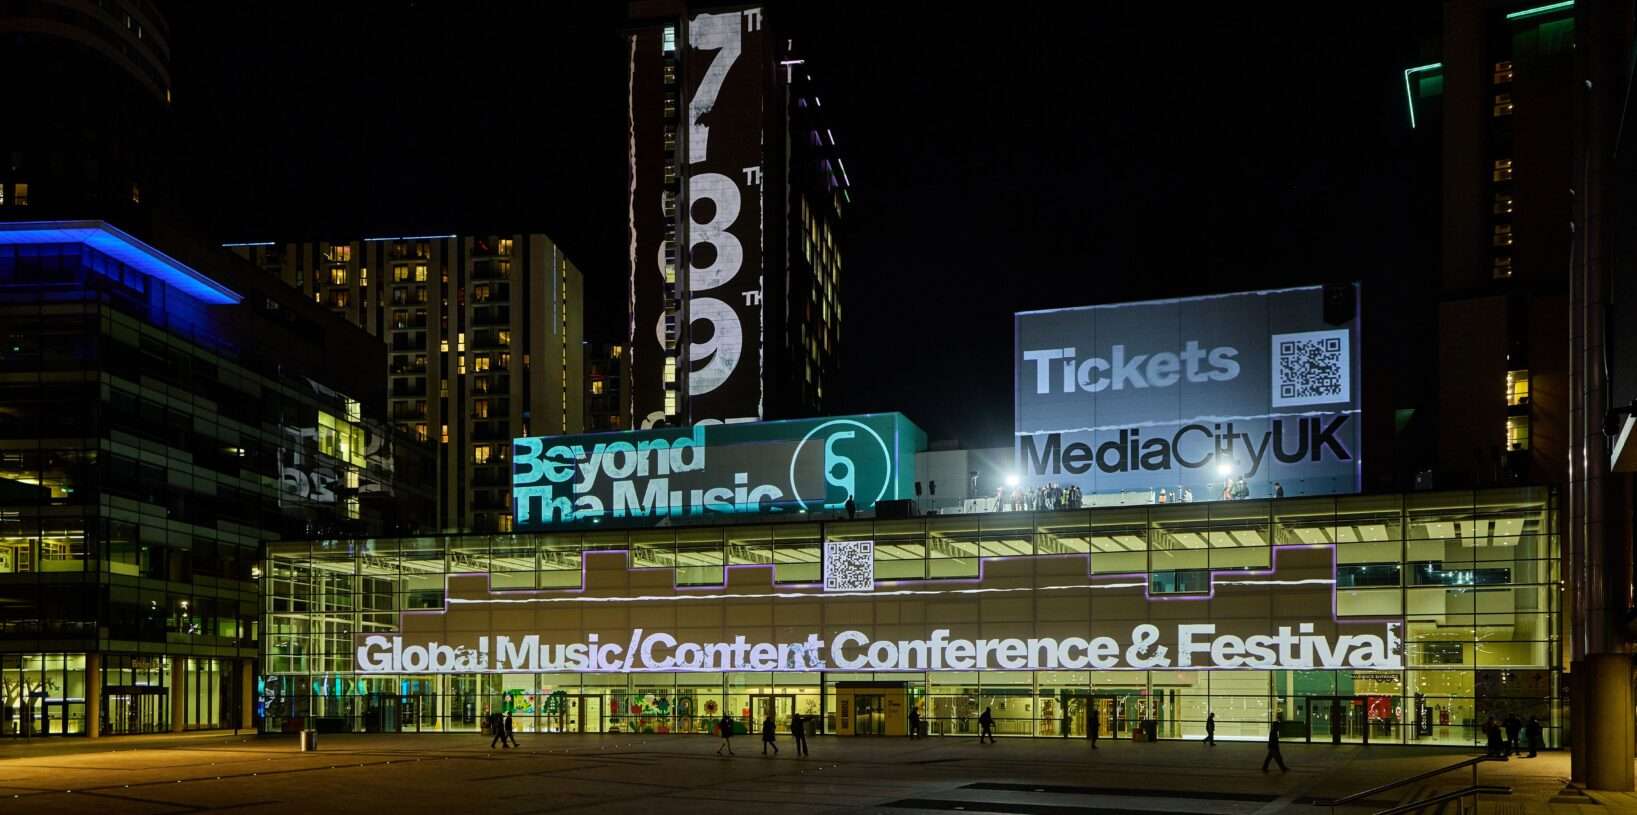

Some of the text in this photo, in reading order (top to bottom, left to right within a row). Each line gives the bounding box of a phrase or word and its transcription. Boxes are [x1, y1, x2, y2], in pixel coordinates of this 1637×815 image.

[1023, 340, 1241, 394] Tickets
[513, 425, 705, 493] Beyond
[1019, 415, 1352, 479] MediaCityUK
[612, 472, 784, 518] Music
[357, 622, 1401, 672] Global Music/Content Conference & Festival
